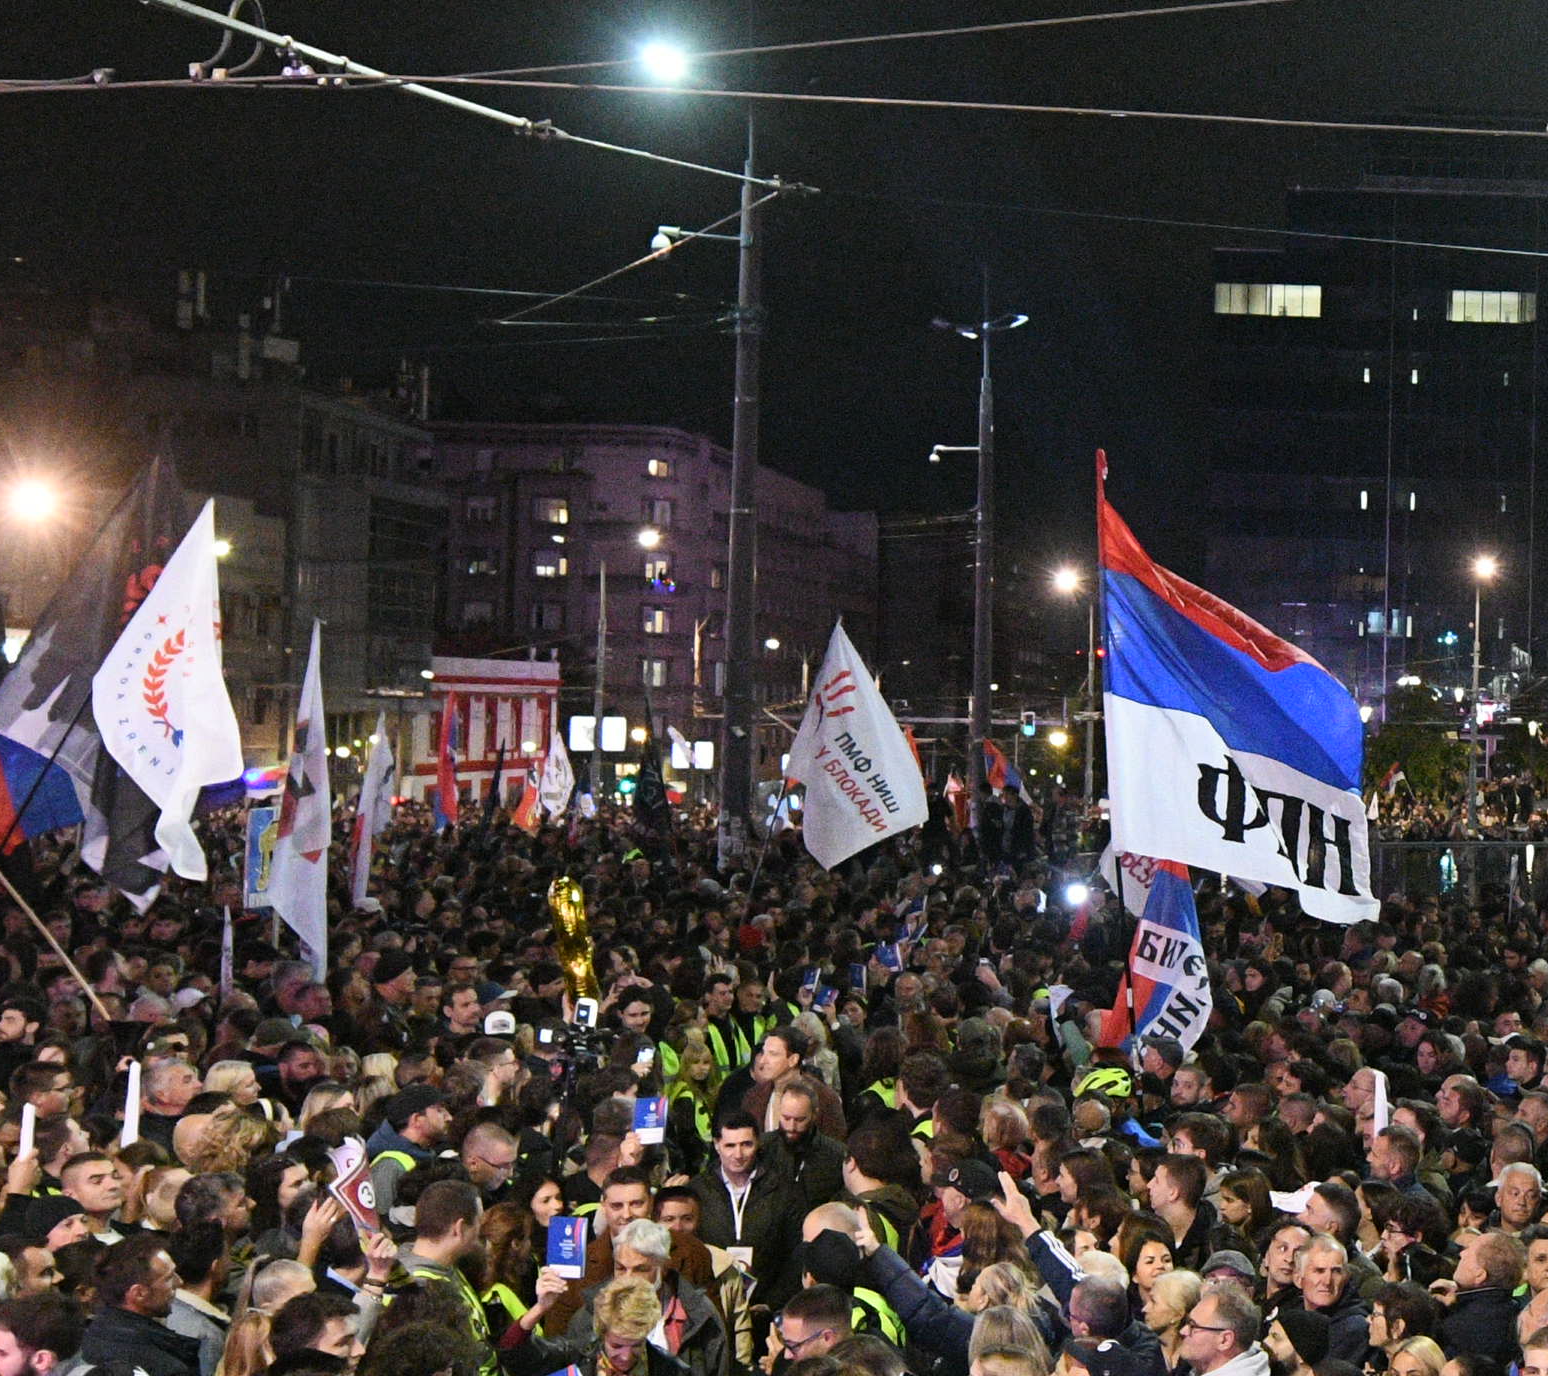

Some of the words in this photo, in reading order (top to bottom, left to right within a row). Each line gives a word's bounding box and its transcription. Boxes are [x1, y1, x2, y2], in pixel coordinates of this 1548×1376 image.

[814, 745, 832, 760] У
[824, 758, 888, 833] БЛОКАДИ
[834, 731, 872, 773] ПМФ
[866, 774, 900, 814] НИШ
